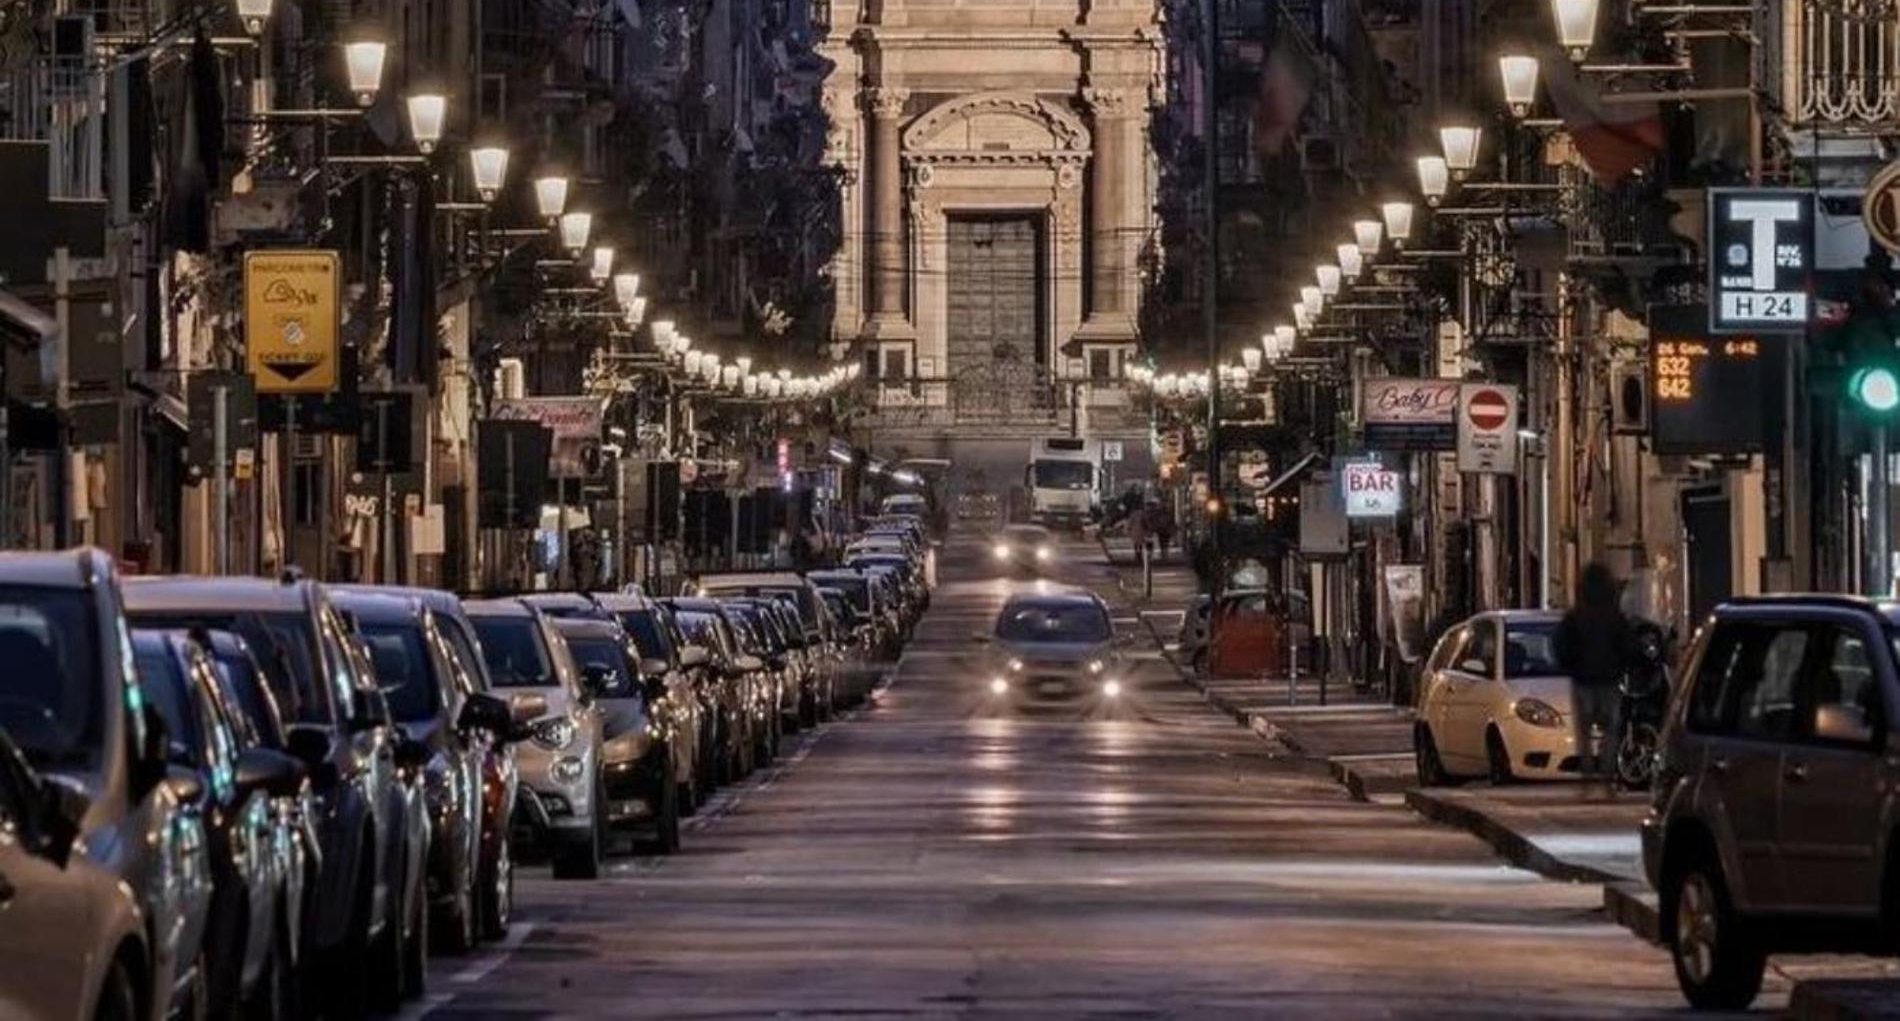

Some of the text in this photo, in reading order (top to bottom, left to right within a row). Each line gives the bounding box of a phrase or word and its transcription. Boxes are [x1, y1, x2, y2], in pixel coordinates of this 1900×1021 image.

[1730, 200, 1798, 290] T
[1736, 296, 1791, 316] H 24
[1658, 357, 1690, 375] 632
[1658, 378, 1691, 397] 642
[1379, 386, 1431, 412] Baby
[1349, 474, 1393, 491] BAR
